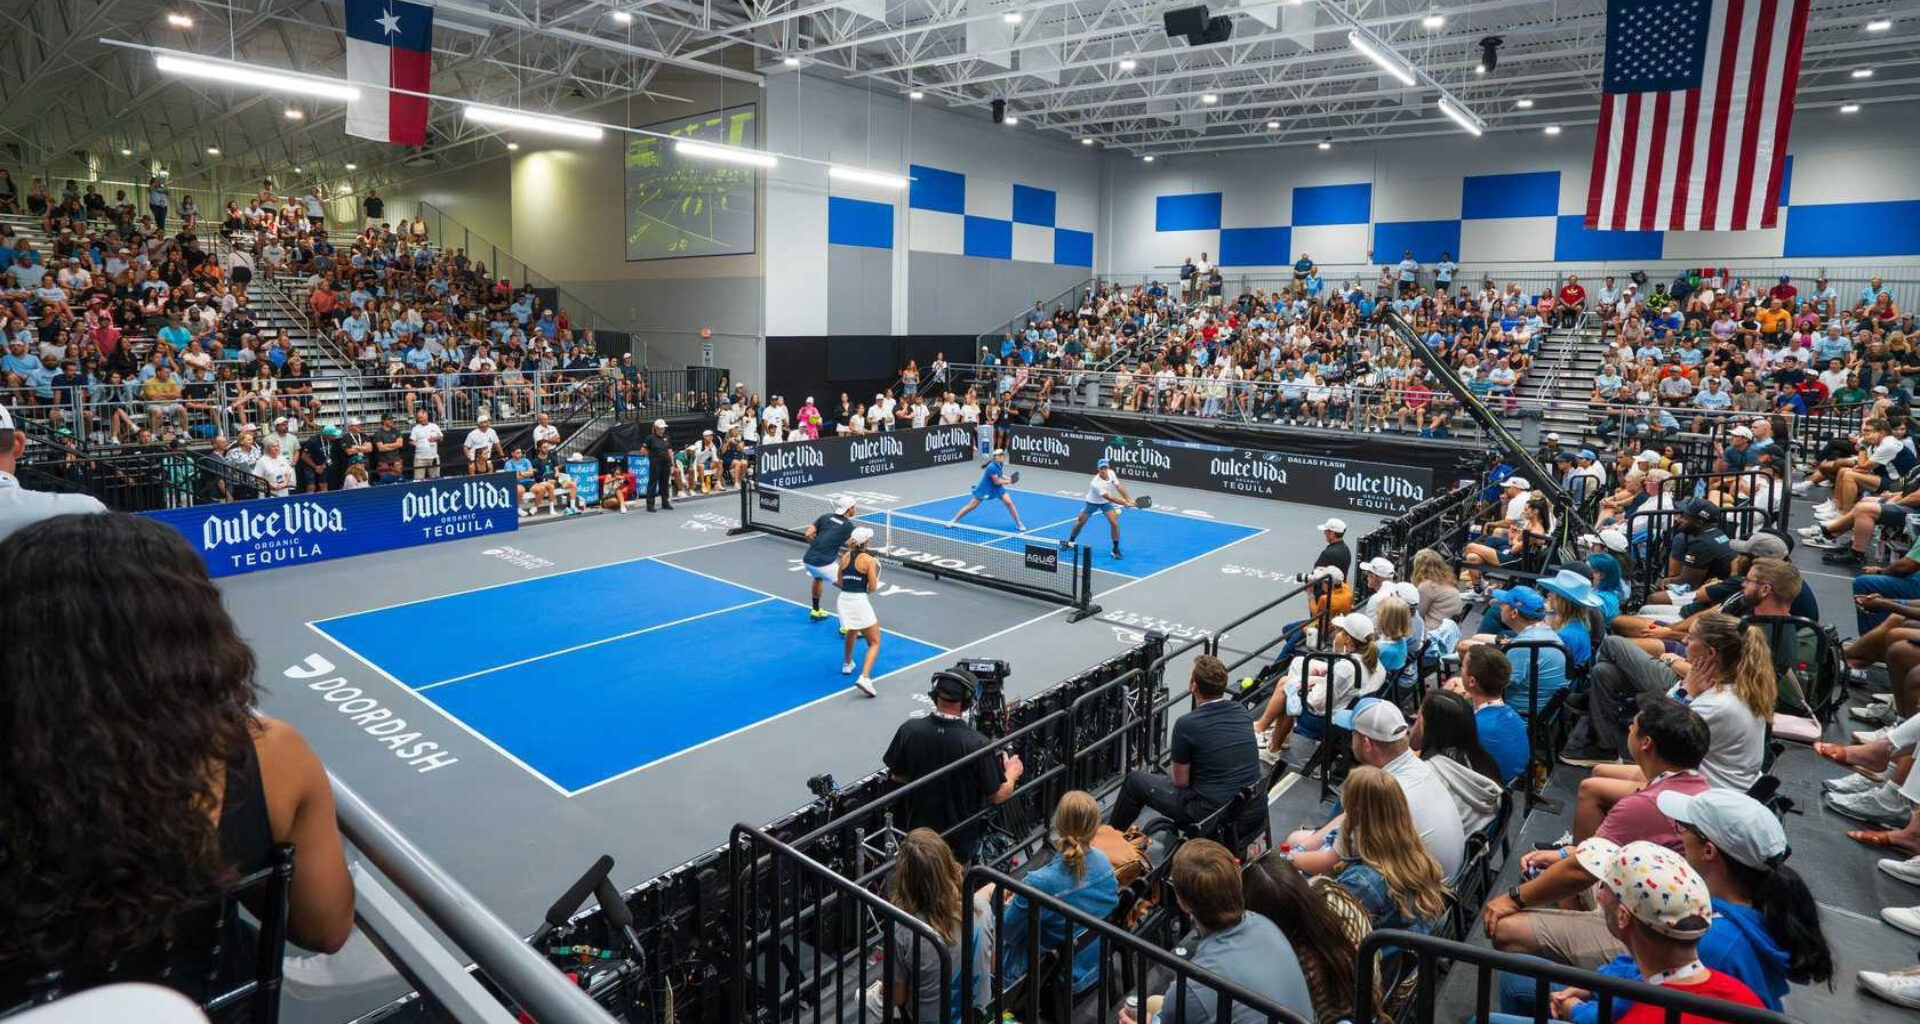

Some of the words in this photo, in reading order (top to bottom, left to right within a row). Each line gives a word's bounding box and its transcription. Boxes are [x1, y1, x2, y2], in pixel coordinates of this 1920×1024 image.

[925, 431, 951, 452] Dulce
[951, 427, 971, 447] Vida
[1012, 434, 1042, 452] Dulce
[1042, 437, 1070, 458] Vida
[1136, 439, 1144, 447] 2
[850, 439, 880, 463] Dulce
[881, 435, 903, 457] Vida
[933, 451, 963, 463] TEQUILA
[1104, 445, 1138, 464] Dulce
[1140, 447, 1171, 470] Vida
[1244, 451, 1251, 459] 2
[761, 450, 796, 474] Dulce
[797, 445, 824, 468] Vida
[860, 462, 895, 474] TEQUILA
[1021, 454, 1059, 467] TEQUILA
[1287, 456, 1318, 466] DALLAS
[1319, 460, 1346, 469] FLASH
[1115, 466, 1159, 480] TEQUILA
[1210, 457, 1250, 477] Dulce
[1251, 461, 1288, 485] Vida
[772, 474, 814, 488] TEQUILA
[1223, 480, 1273, 495] TEQUILA
[1334, 472, 1380, 494] Dulce
[1382, 475, 1425, 501] Vida
[401, 487, 462, 523] Dulce
[463, 481, 511, 511] Vida
[1347, 497, 1407, 513] TEQUILA
[202, 509, 281, 551] Dulce
[282, 501, 346, 537] Vida
[441, 513, 477, 524] ORGANIC
[423, 519, 494, 539] TEQUILA
[254, 537, 300, 550] ORGANIC
[231, 544, 323, 568] TEQUILA
[308, 677, 459, 773] DOORDASH
